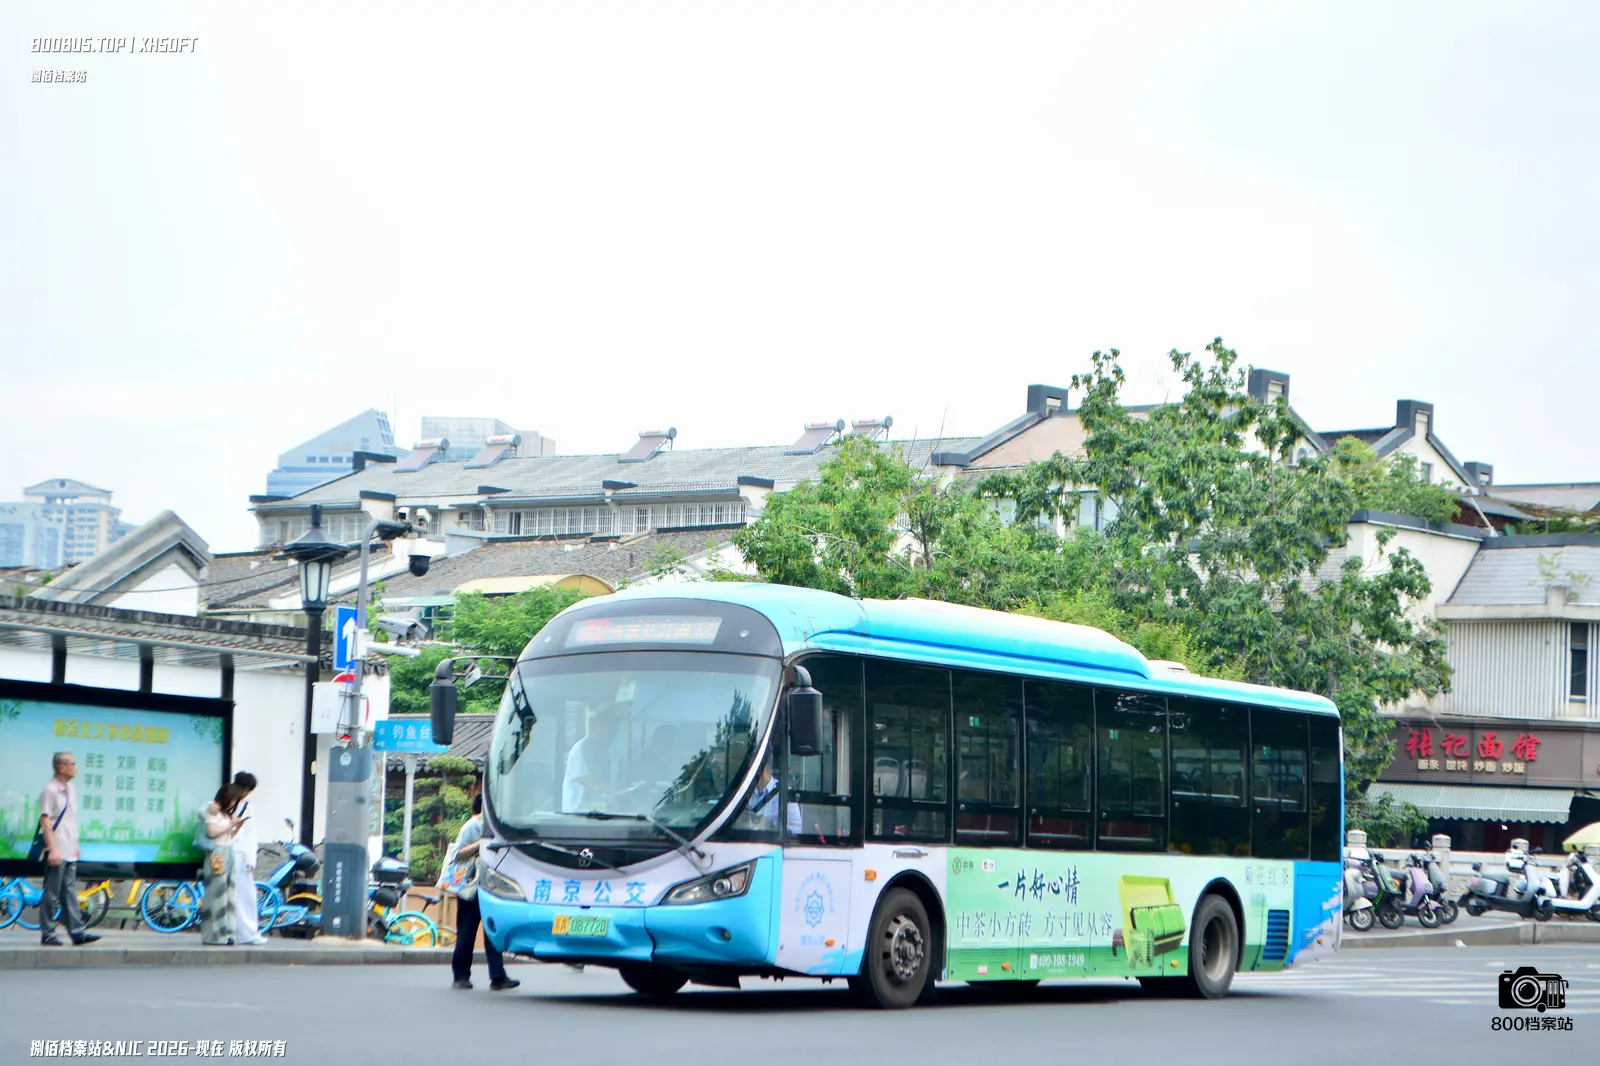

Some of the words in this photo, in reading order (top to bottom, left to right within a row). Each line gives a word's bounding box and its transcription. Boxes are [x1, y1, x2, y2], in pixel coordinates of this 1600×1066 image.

[392, 724, 432, 740] 钓鱼台
[534, 879, 646, 905] 南京公交
[998, 864, 1081, 906] 一片好心情
[956, 911, 1032, 938] 中茶小方砖
[1044, 911, 1113, 938] 方寸见从容
